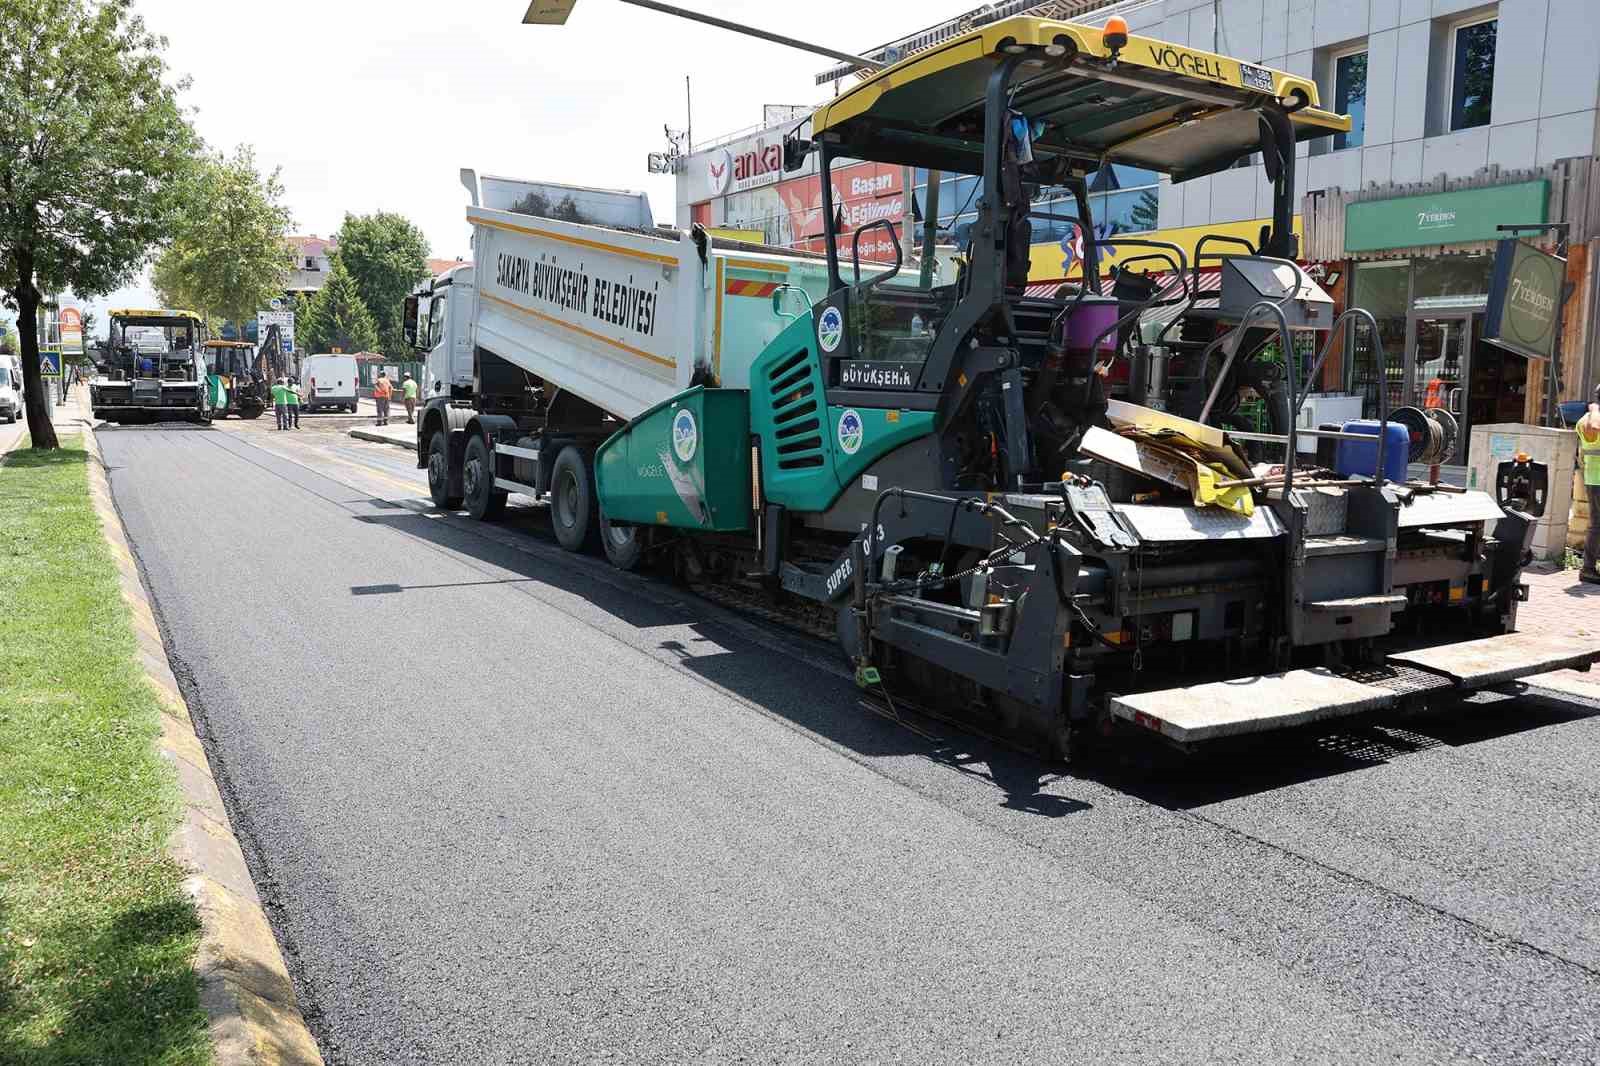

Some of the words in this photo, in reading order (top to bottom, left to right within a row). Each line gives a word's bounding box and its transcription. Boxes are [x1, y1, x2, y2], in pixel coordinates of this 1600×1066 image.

[734, 139, 784, 180] anka
[496, 252, 530, 294] SAKARYA
[533, 254, 589, 313] BÜYÜKŞEHİR
[593, 275, 658, 336] BELEDİYESİ
[842, 364, 911, 387] BÜYÜKŞEHİR
[826, 558, 853, 595] SUPER
